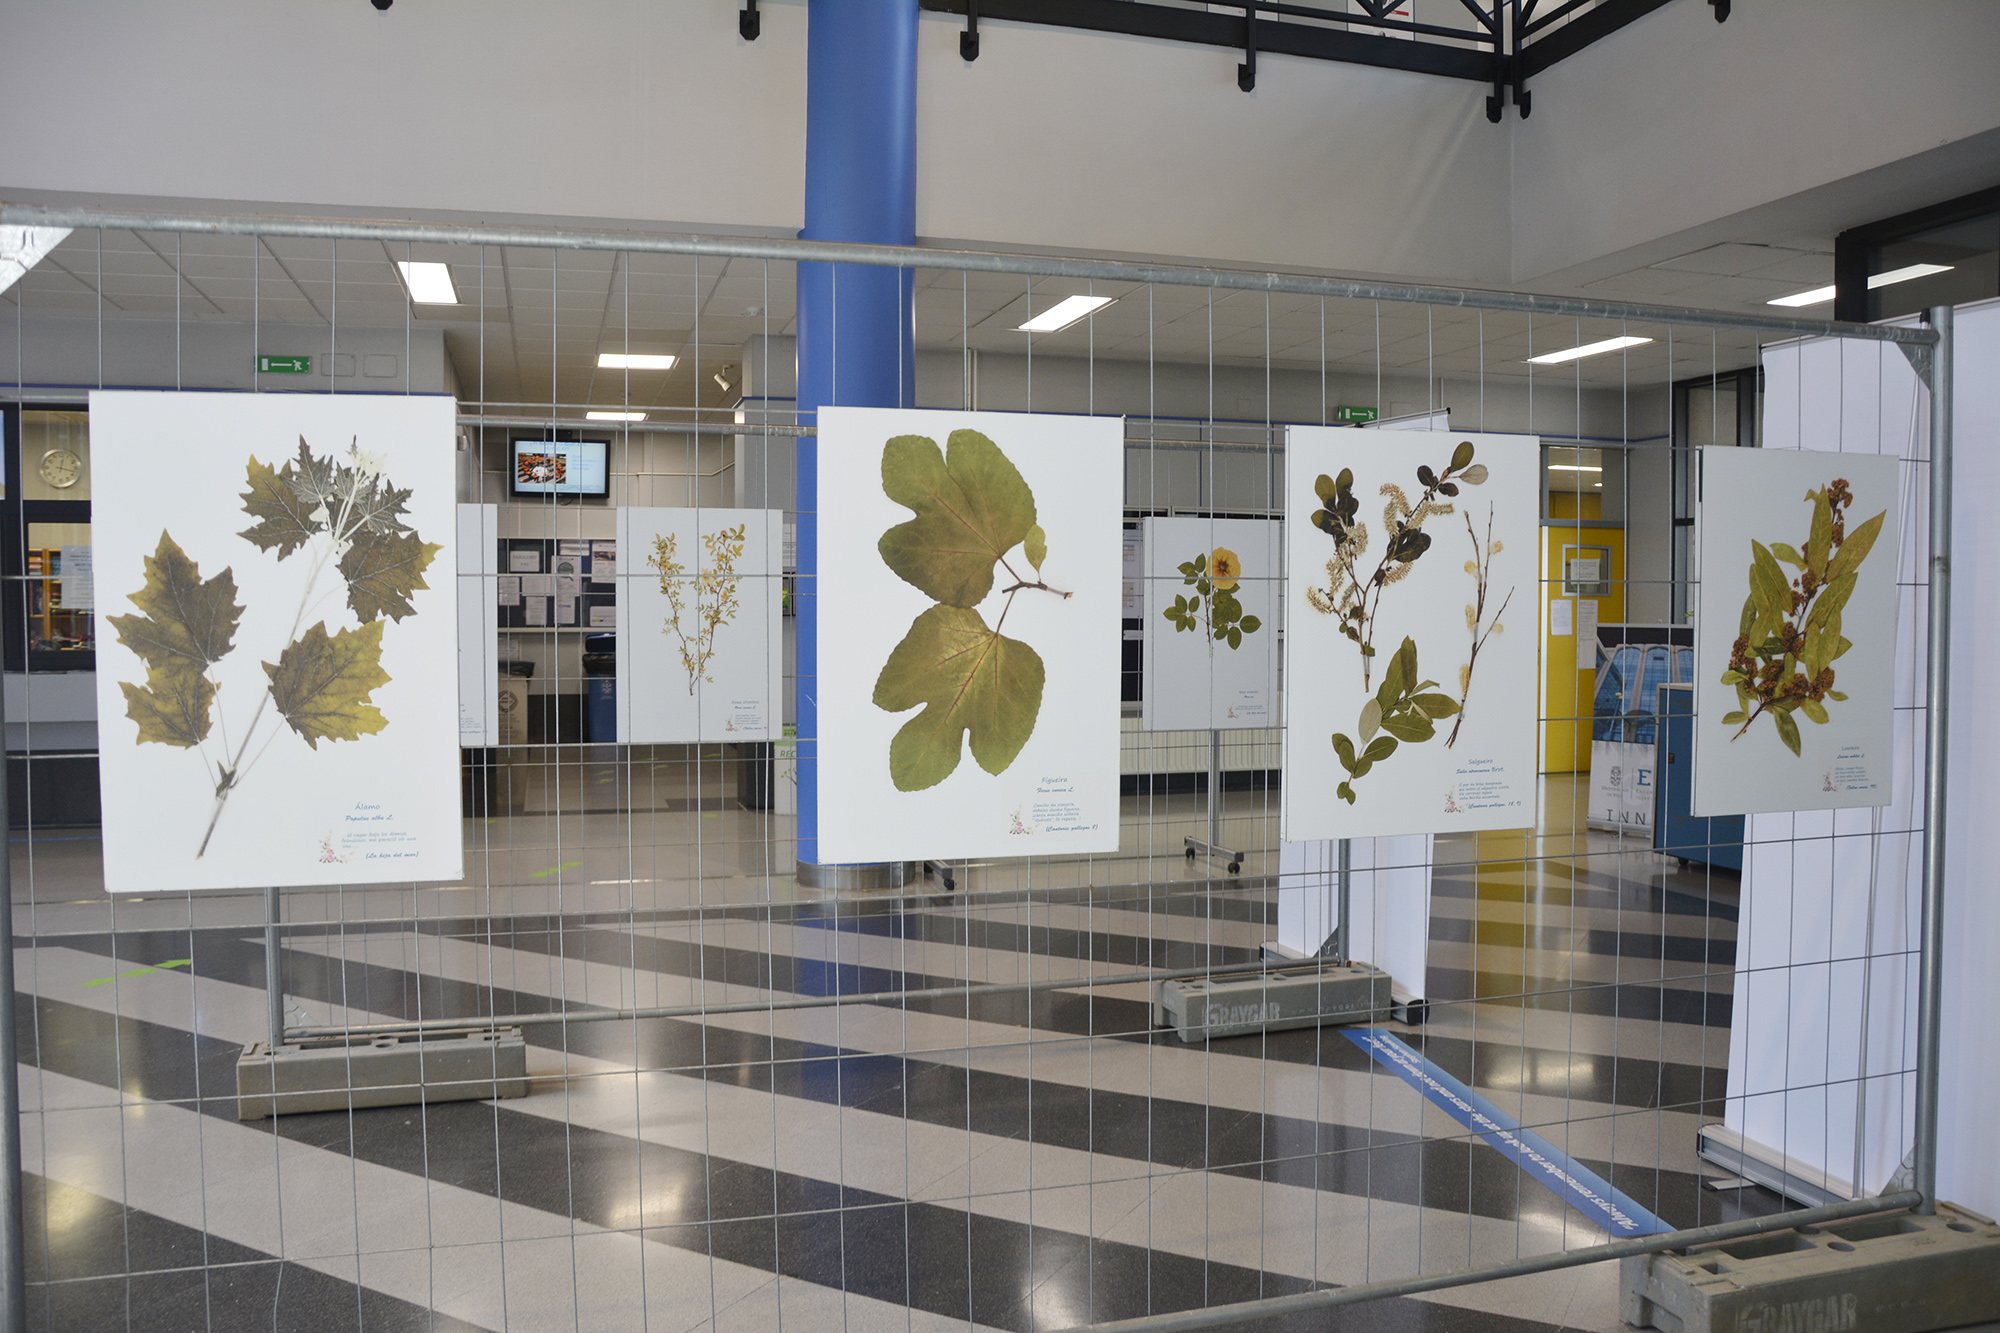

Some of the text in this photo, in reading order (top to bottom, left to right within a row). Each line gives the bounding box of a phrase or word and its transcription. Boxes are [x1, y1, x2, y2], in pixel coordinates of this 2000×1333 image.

[1468, 758, 1494, 766] Salgueiro
[1041, 776, 1068, 785] Figueira
[355, 802, 381, 810] Álamo
[1539, 1162, 1593, 1197] remember
